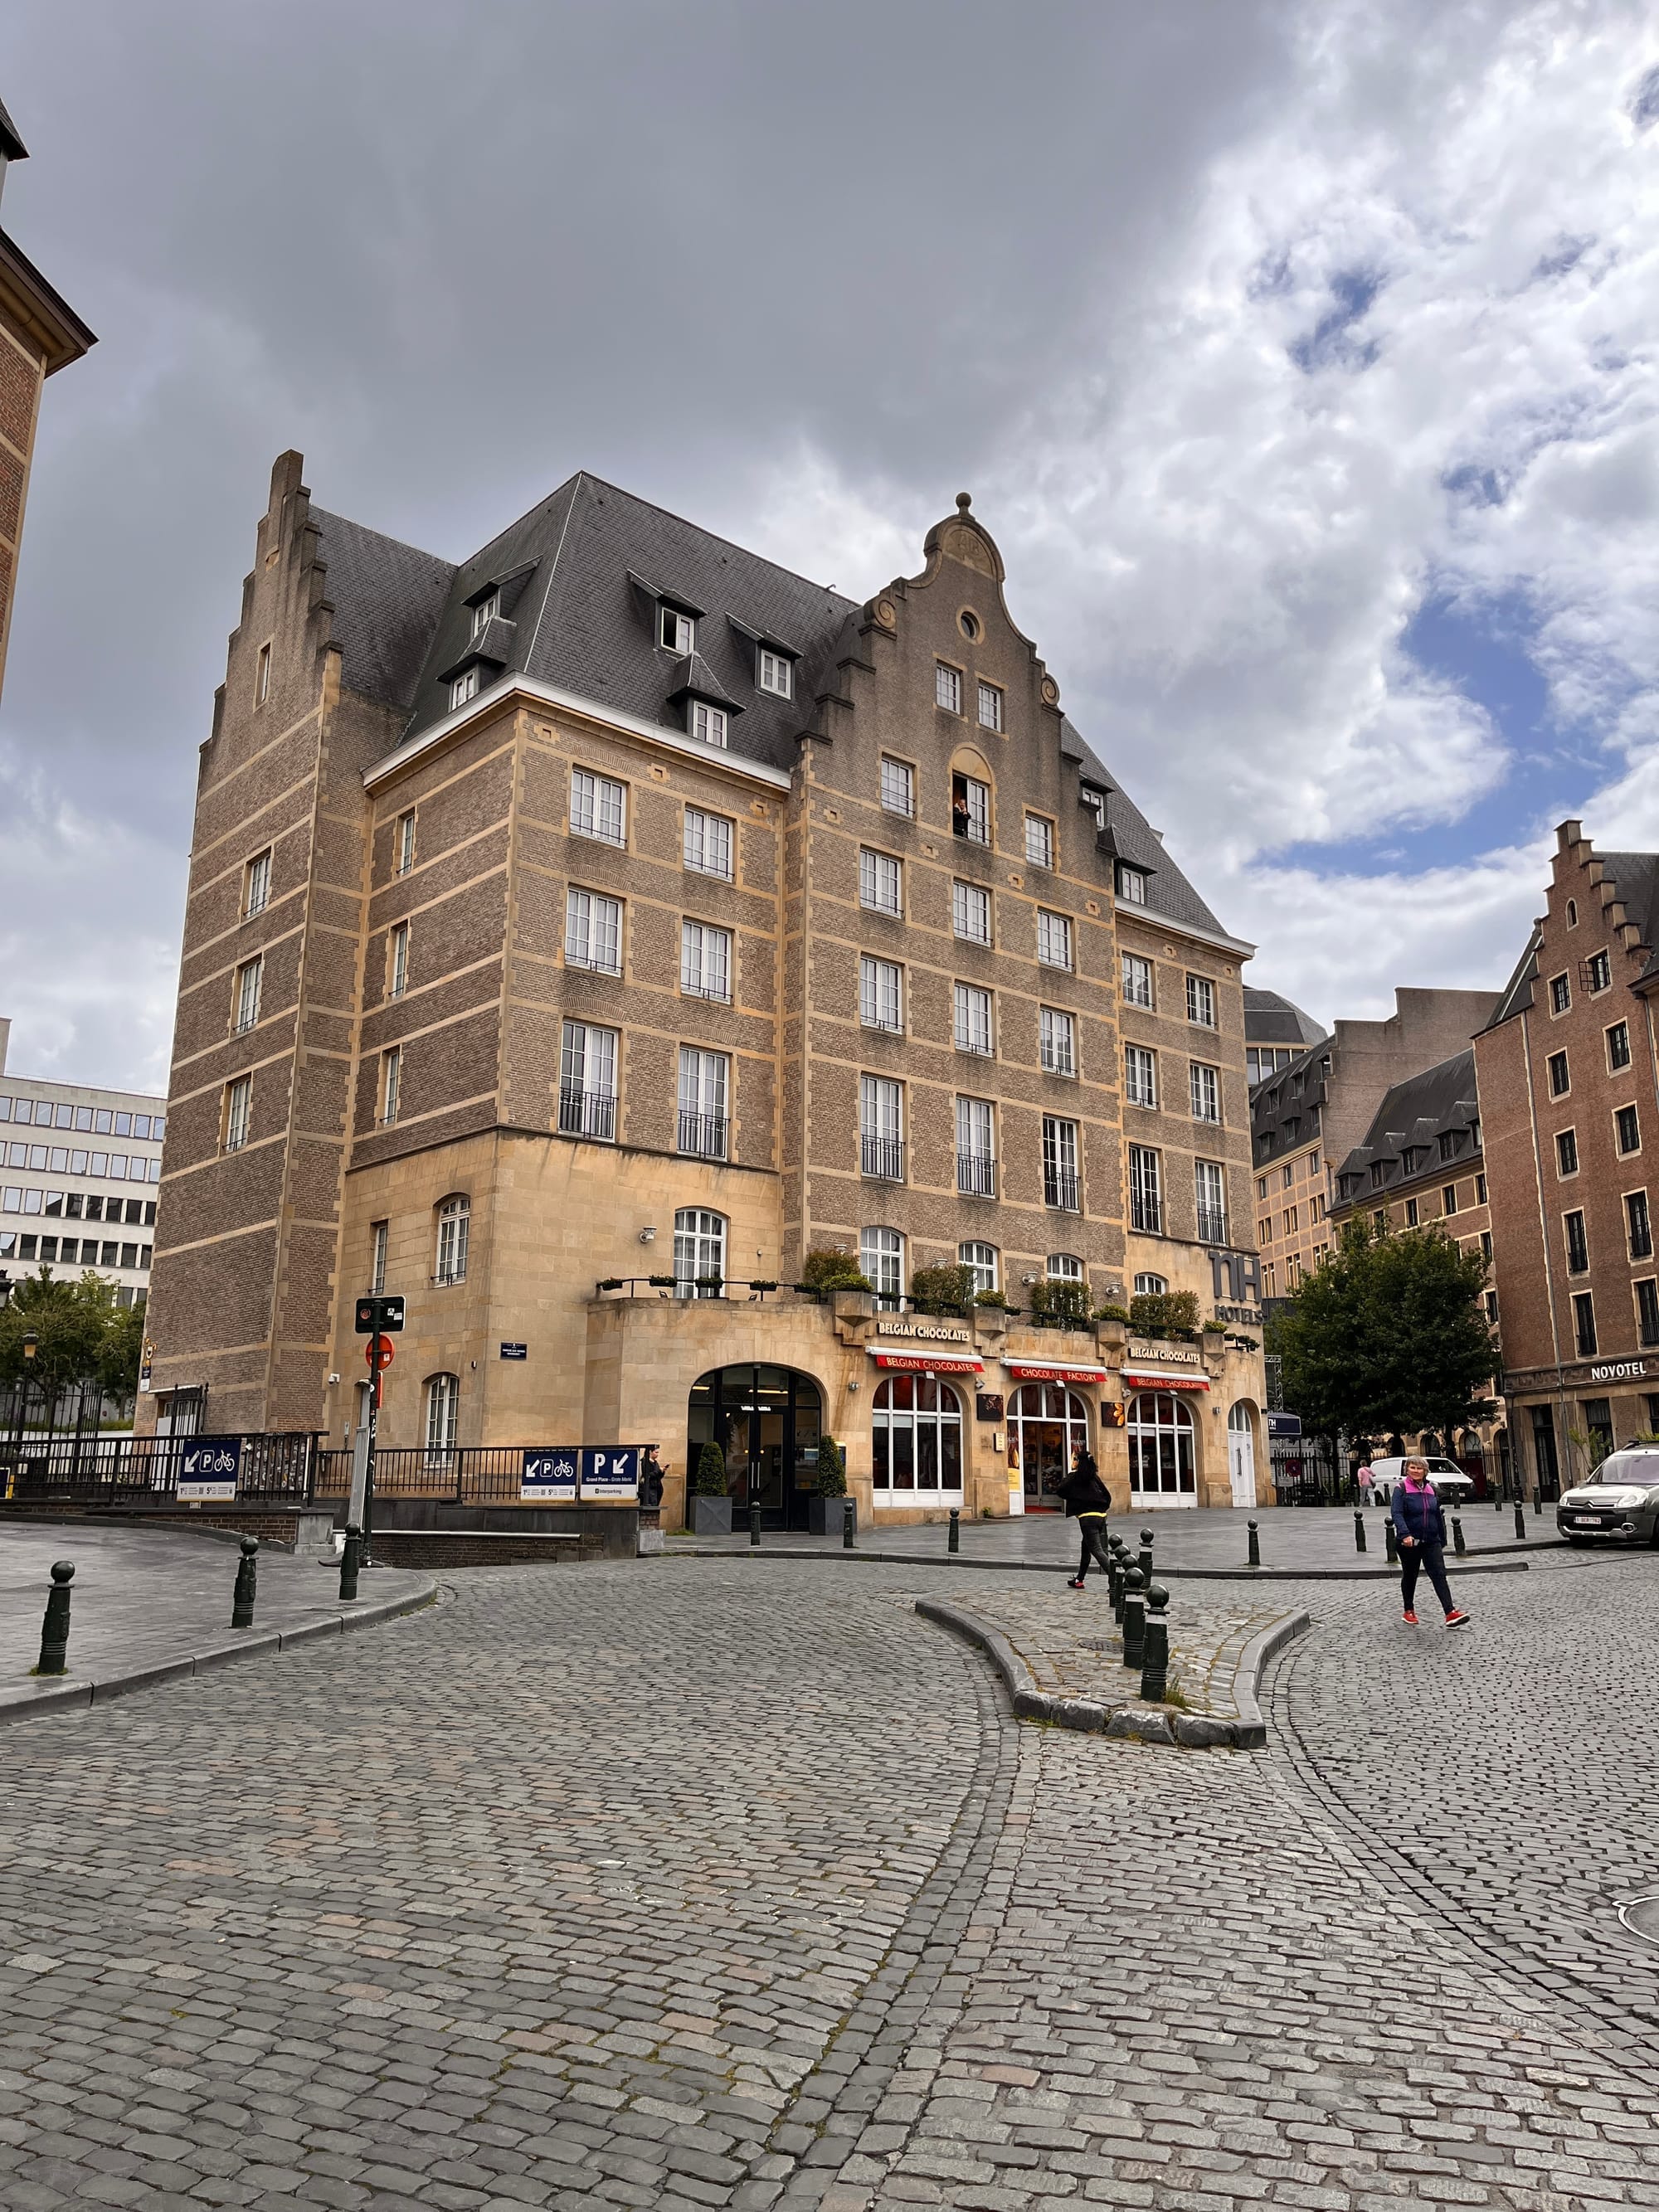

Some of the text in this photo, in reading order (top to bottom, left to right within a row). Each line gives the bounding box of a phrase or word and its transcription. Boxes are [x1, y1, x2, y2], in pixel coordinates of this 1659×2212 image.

[1214, 1305, 1266, 1325] HOTELS
[878, 1322, 971, 1342] BELGIAN CHOCOLATES
[1130, 1347, 1201, 1363] BELGIAN CHOCOLATES
[886, 1357, 975, 1372] BELGIAN CHOCOLATES
[1591, 1362, 1647, 1380] NOVOTEL
[1021, 1368, 1097, 1381] CHOCOLATE FACTORY
[1136, 1378, 1163, 1387] BELGIAN
[203, 1455, 212, 1468] P
[543, 1463, 551, 1474] P
[594, 1453, 606, 1474] P
